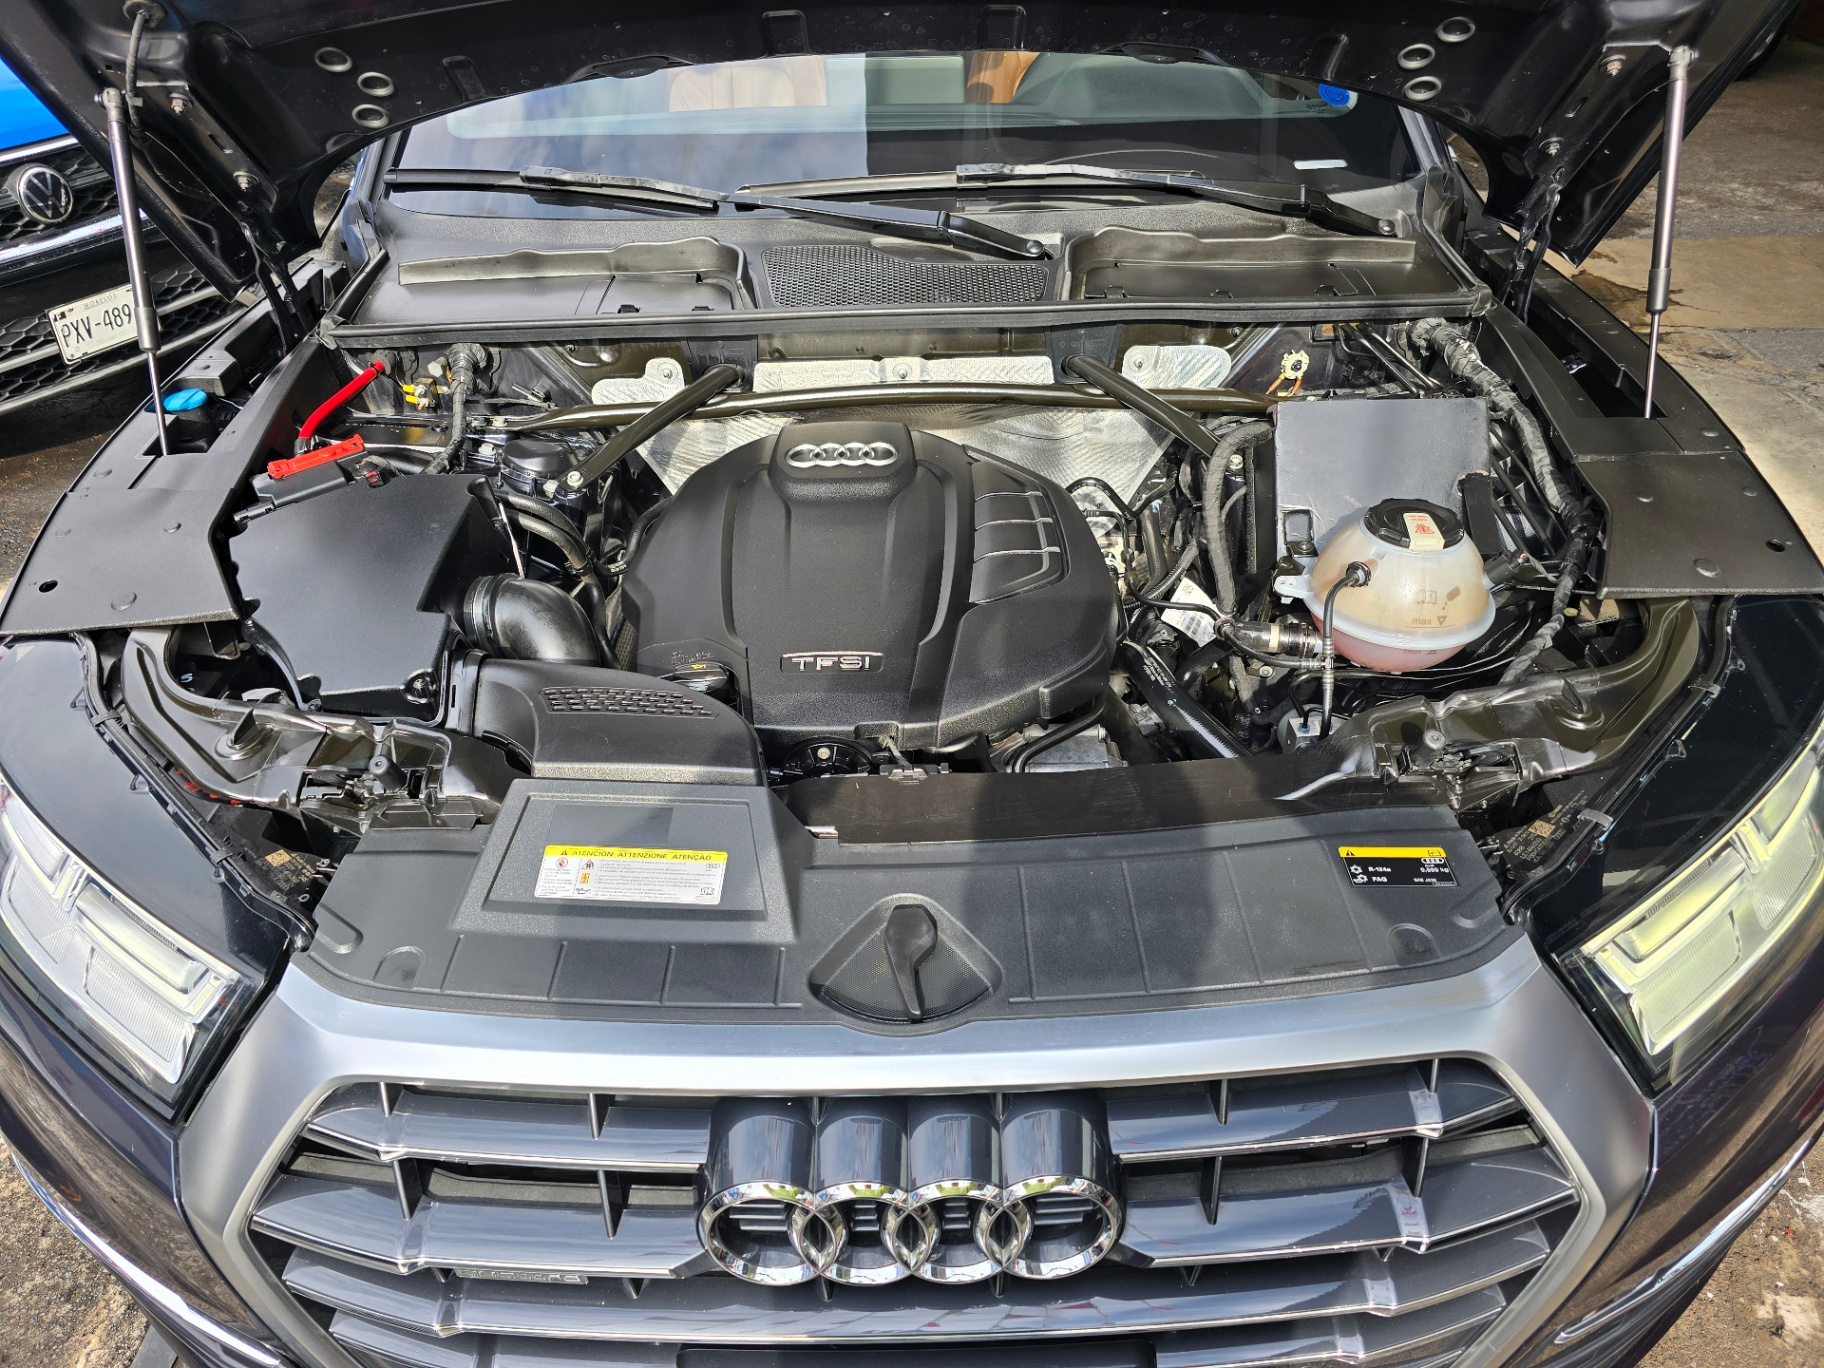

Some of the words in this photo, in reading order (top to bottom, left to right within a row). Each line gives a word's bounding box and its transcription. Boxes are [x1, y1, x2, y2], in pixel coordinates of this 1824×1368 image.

[83, 293, 118, 308] MORELOS
[61, 303, 132, 348] PXV-489
[1412, 617, 1433, 626] max
[791, 655, 870, 672] TFSI
[617, 851, 668, 860] ATTENZIONE
[671, 852, 712, 861] ATENÇÃO
